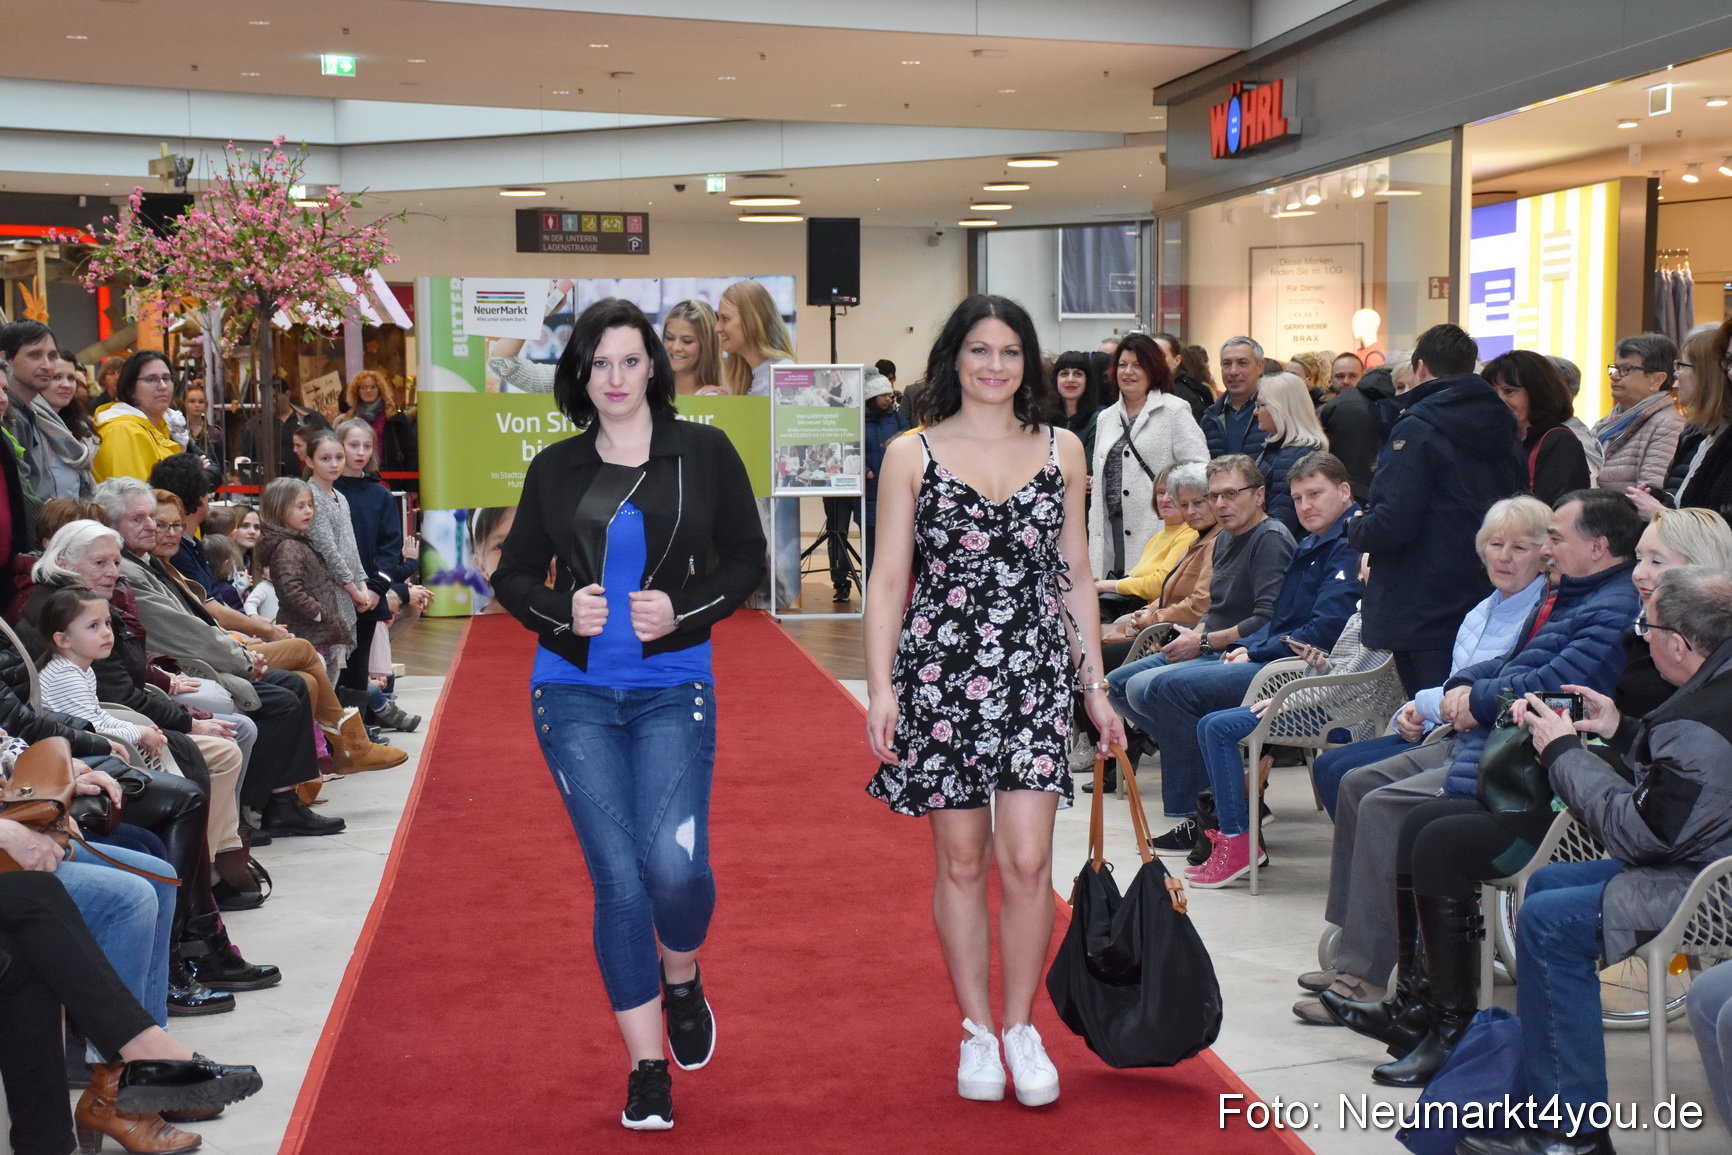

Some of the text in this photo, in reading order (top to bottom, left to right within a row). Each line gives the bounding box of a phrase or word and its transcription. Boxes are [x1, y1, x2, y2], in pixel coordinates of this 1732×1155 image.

[1208, 78, 1288, 160] WÖHRL
[566, 235, 598, 243] UNTEREN
[543, 244, 598, 252] LADENSTRASSE
[1296, 267, 1309, 275] Sie
[474, 305, 528, 315] NeuerMarkt
[1293, 335, 1320, 343] BRAX
[495, 412, 541, 434] Von
[522, 440, 551, 462] bi
